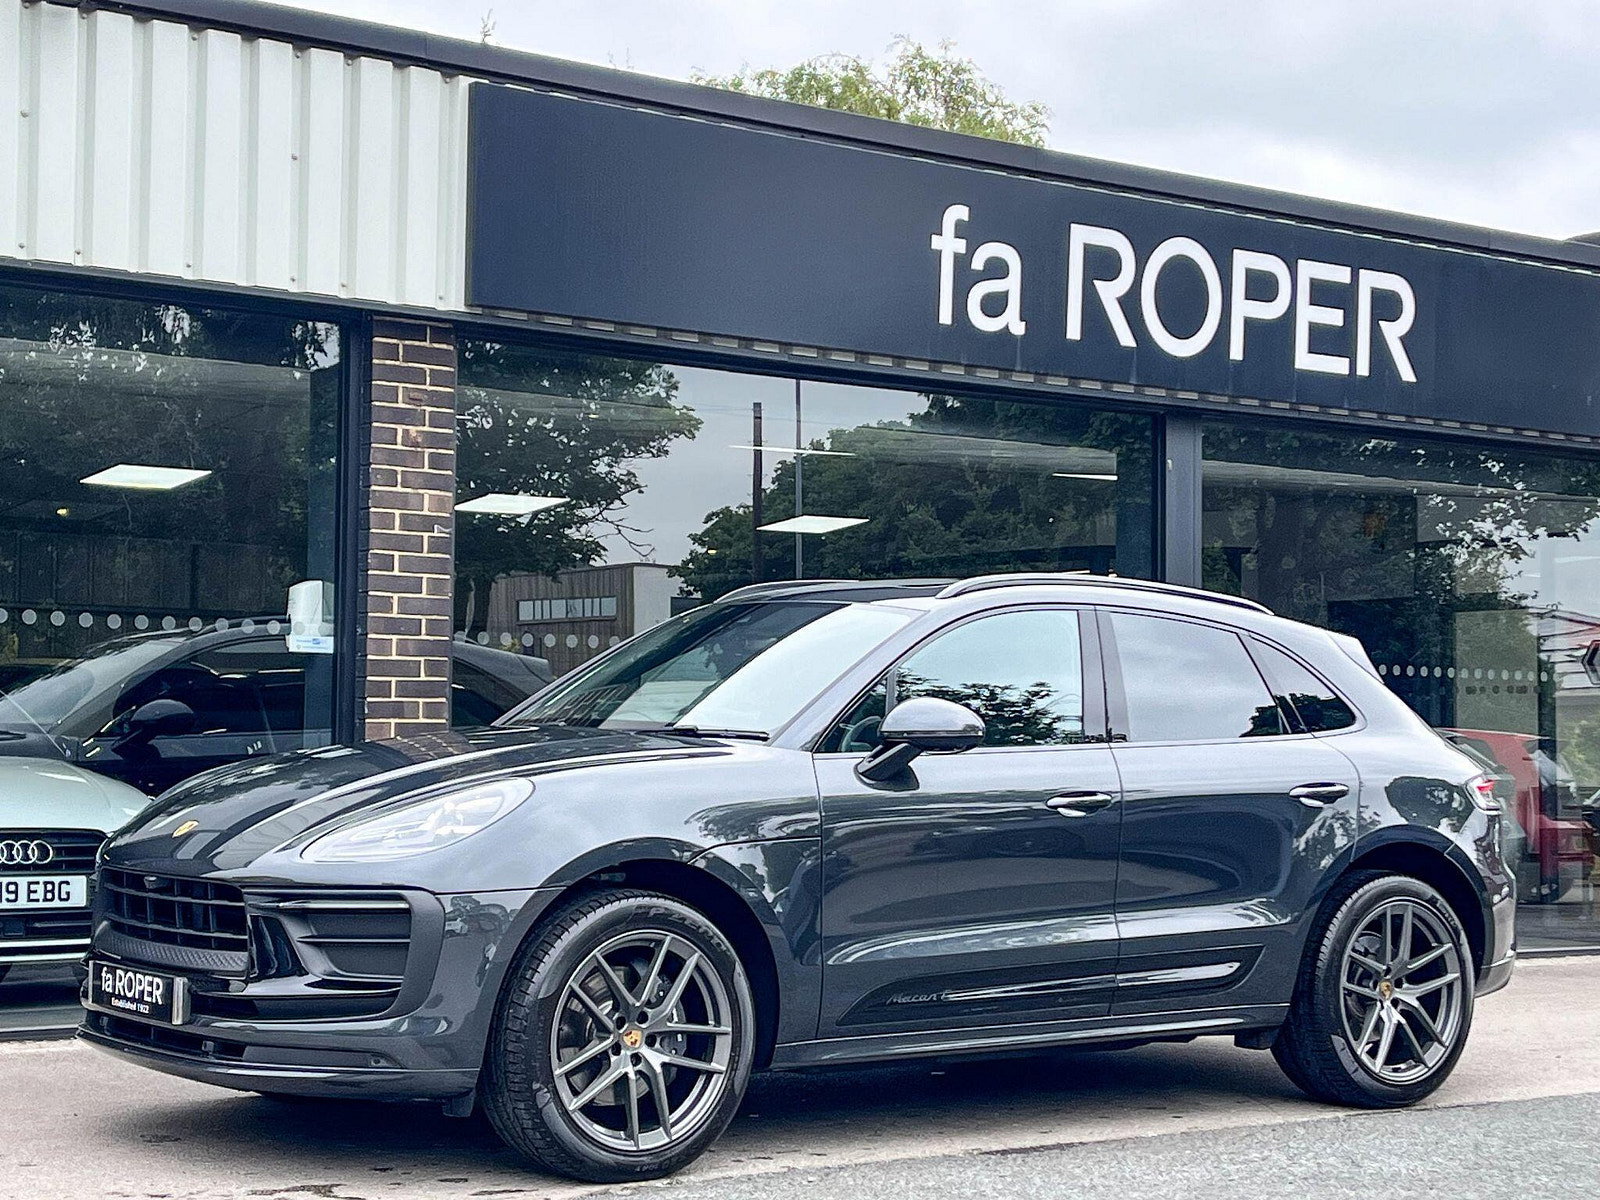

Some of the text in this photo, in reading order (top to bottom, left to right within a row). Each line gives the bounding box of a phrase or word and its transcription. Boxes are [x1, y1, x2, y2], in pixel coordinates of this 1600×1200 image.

[930, 204, 1417, 383] fa ROPER
[27, 880, 71, 902] EBG
[101, 966, 163, 1005] fa ROPER
